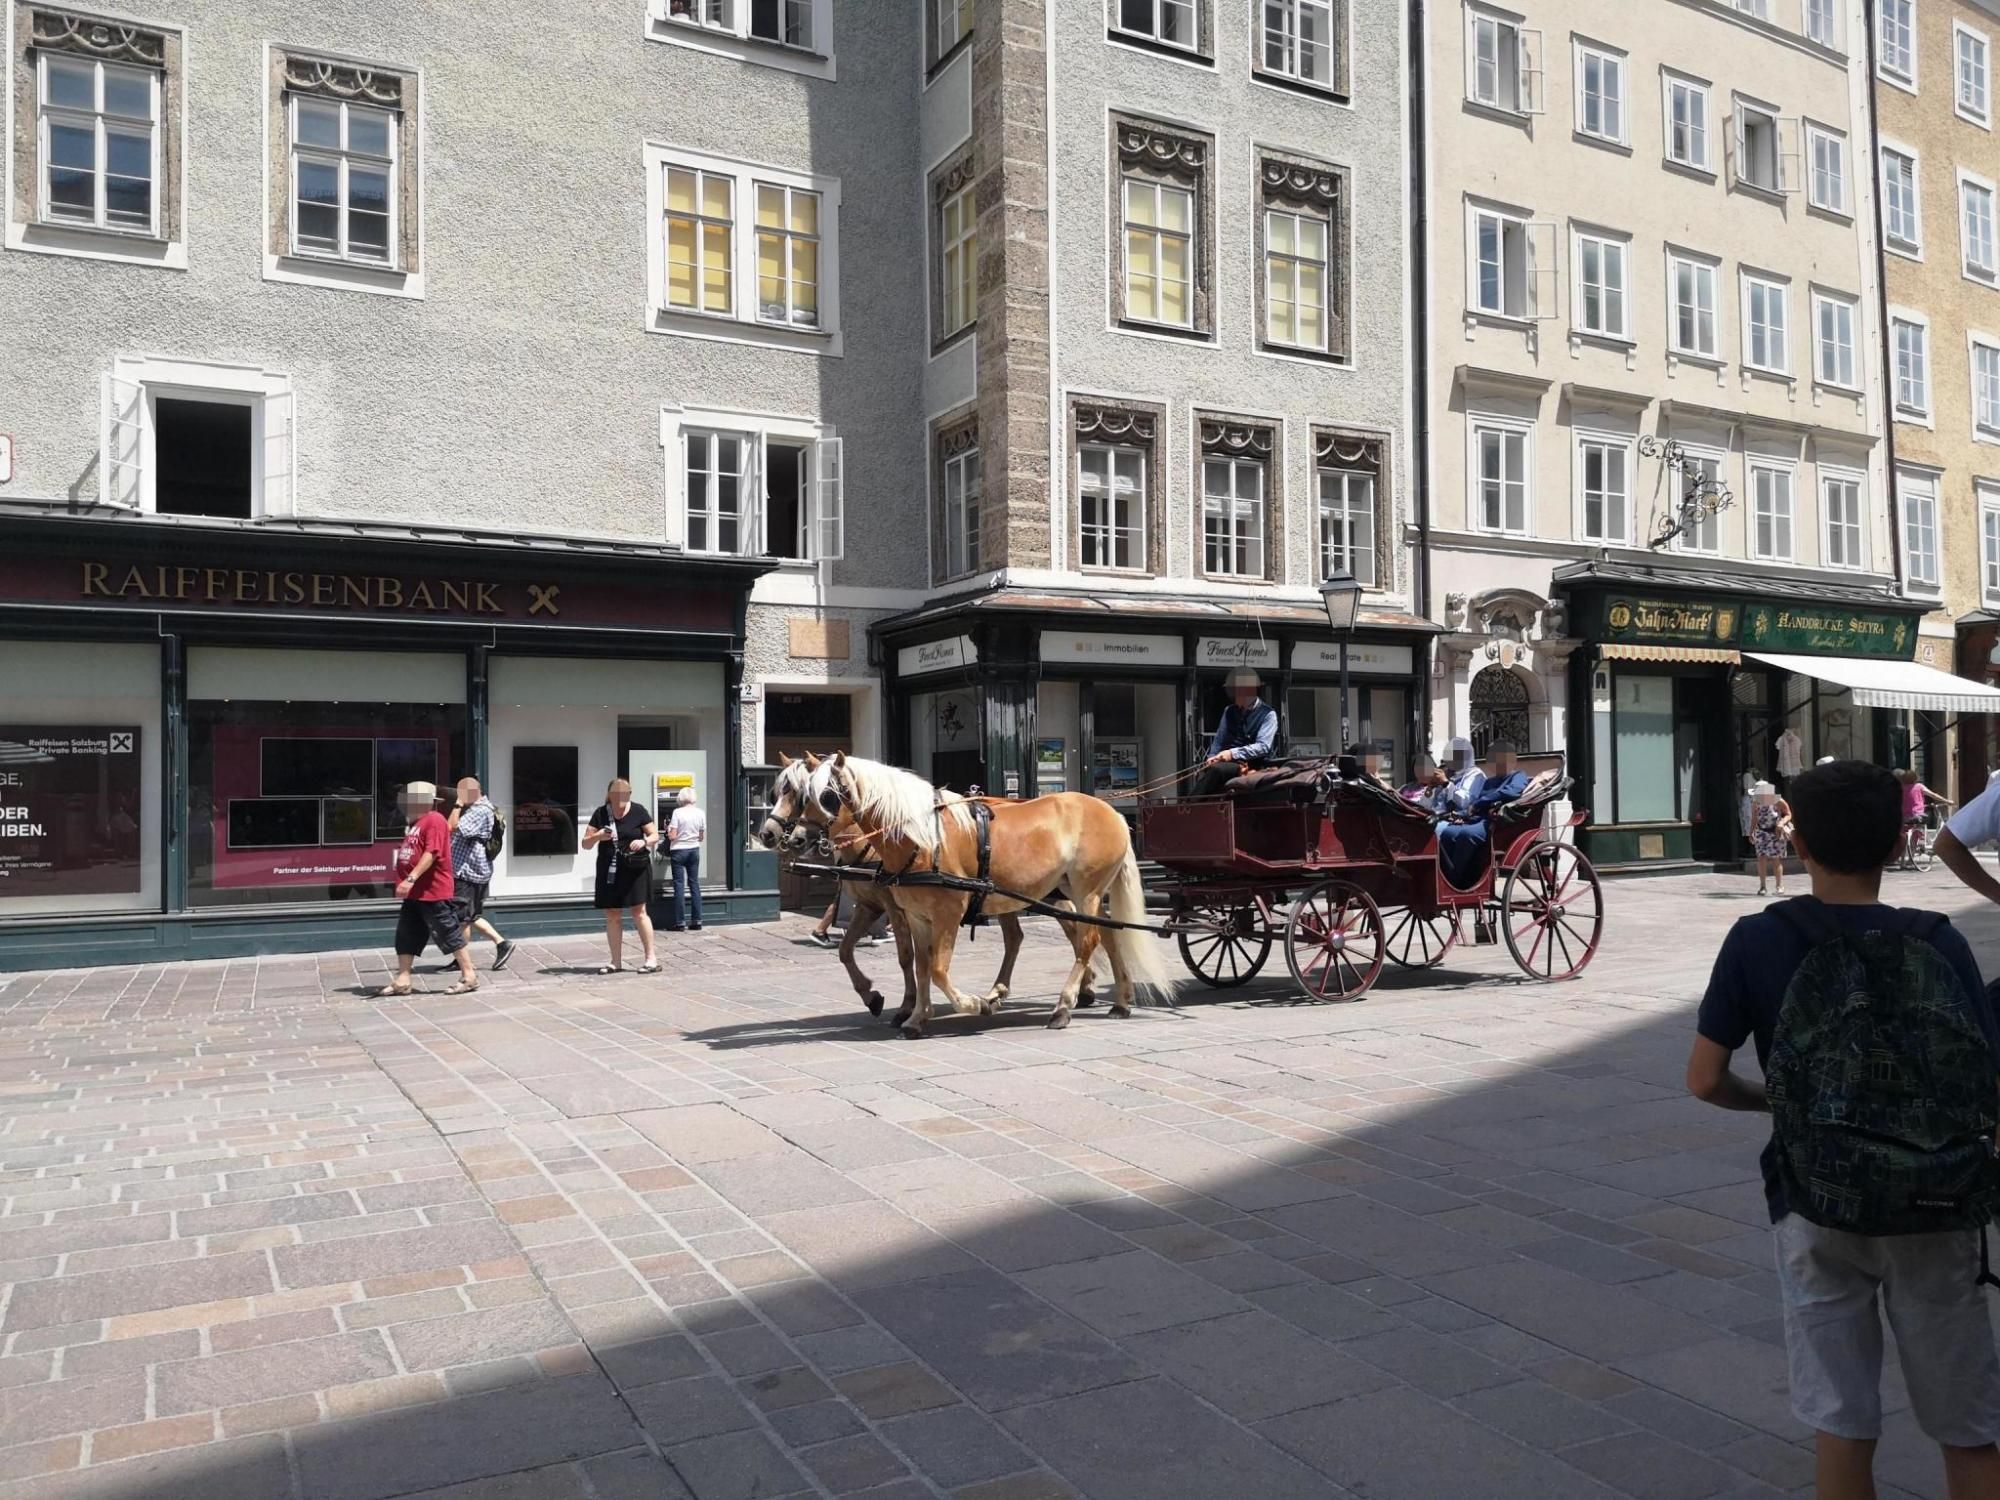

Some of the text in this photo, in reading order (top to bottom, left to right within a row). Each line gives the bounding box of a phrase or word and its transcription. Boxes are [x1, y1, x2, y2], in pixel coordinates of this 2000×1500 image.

[80, 562, 504, 612] RAIFFEISENBANK
[1104, 643, 1150, 653] Immobilien
[744, 685, 752, 695] 2
[28, 739, 108, 749] Raiffeisen Salzburg
[71, 747, 108, 755] Banking
[313, 865, 351, 874] Salzburger
